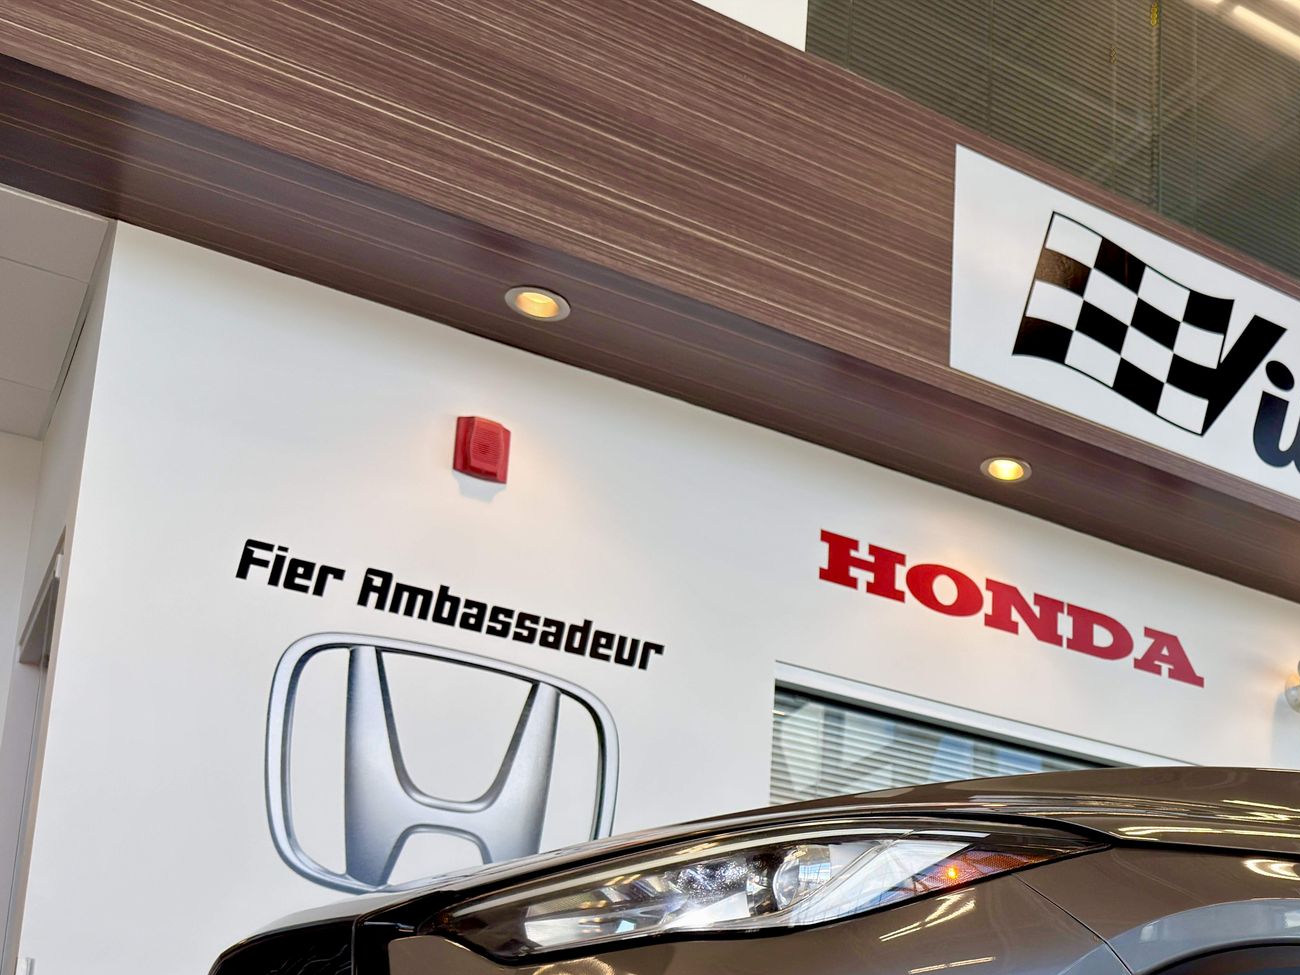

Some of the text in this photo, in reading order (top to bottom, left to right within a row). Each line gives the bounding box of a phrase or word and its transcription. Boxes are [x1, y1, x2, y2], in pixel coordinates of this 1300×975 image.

[236, 539, 665, 669] Fier Ambassadeur
[819, 529, 1204, 688] HONDA
